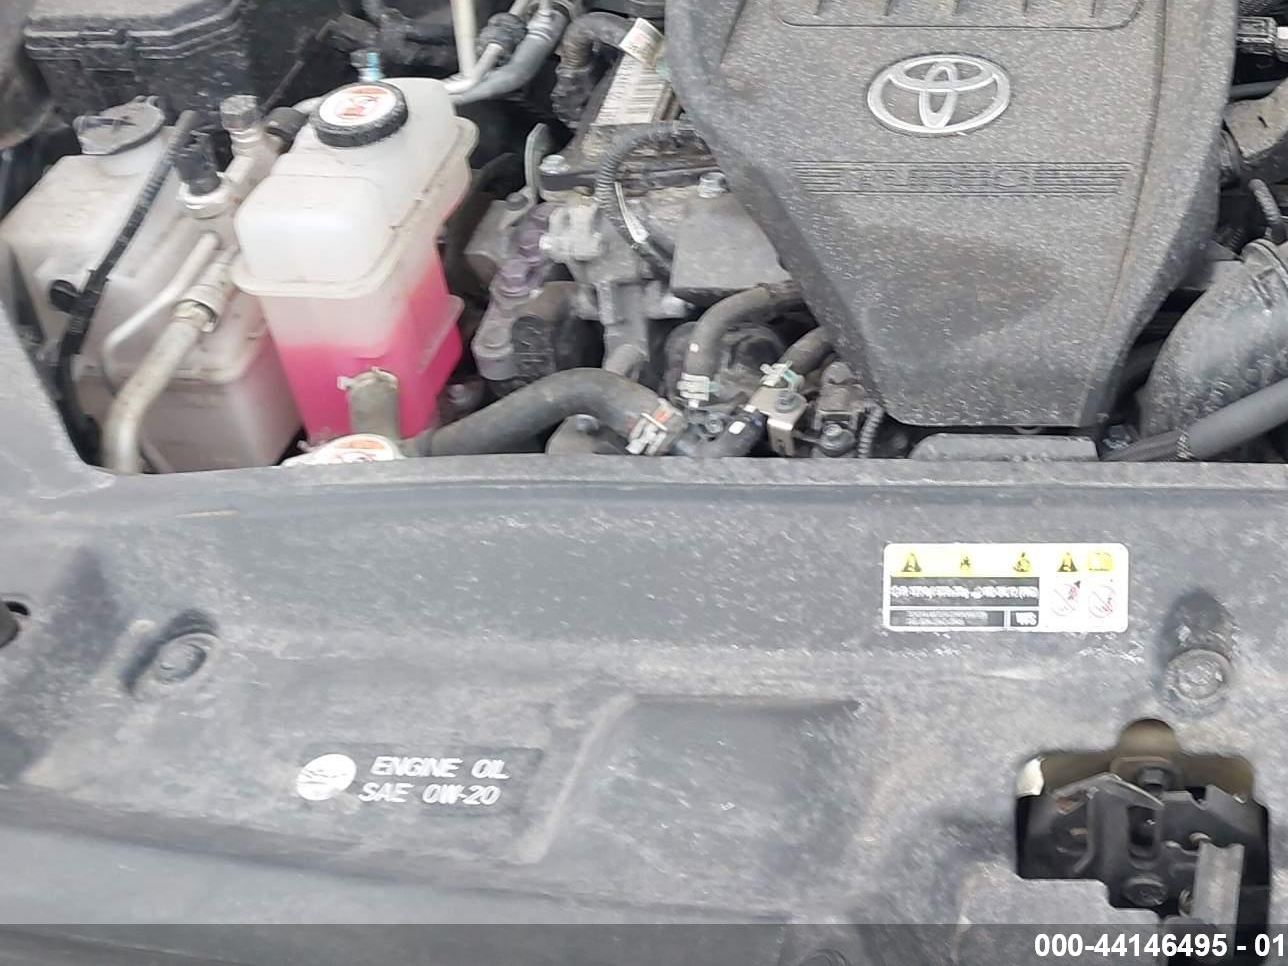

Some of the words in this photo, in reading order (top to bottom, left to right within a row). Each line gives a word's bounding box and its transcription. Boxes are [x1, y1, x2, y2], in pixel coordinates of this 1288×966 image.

[370, 755, 463, 778] ENGINE
[471, 758, 511, 780] OIL
[358, 782, 415, 804] SAE
[422, 784, 501, 805] 0W-20
